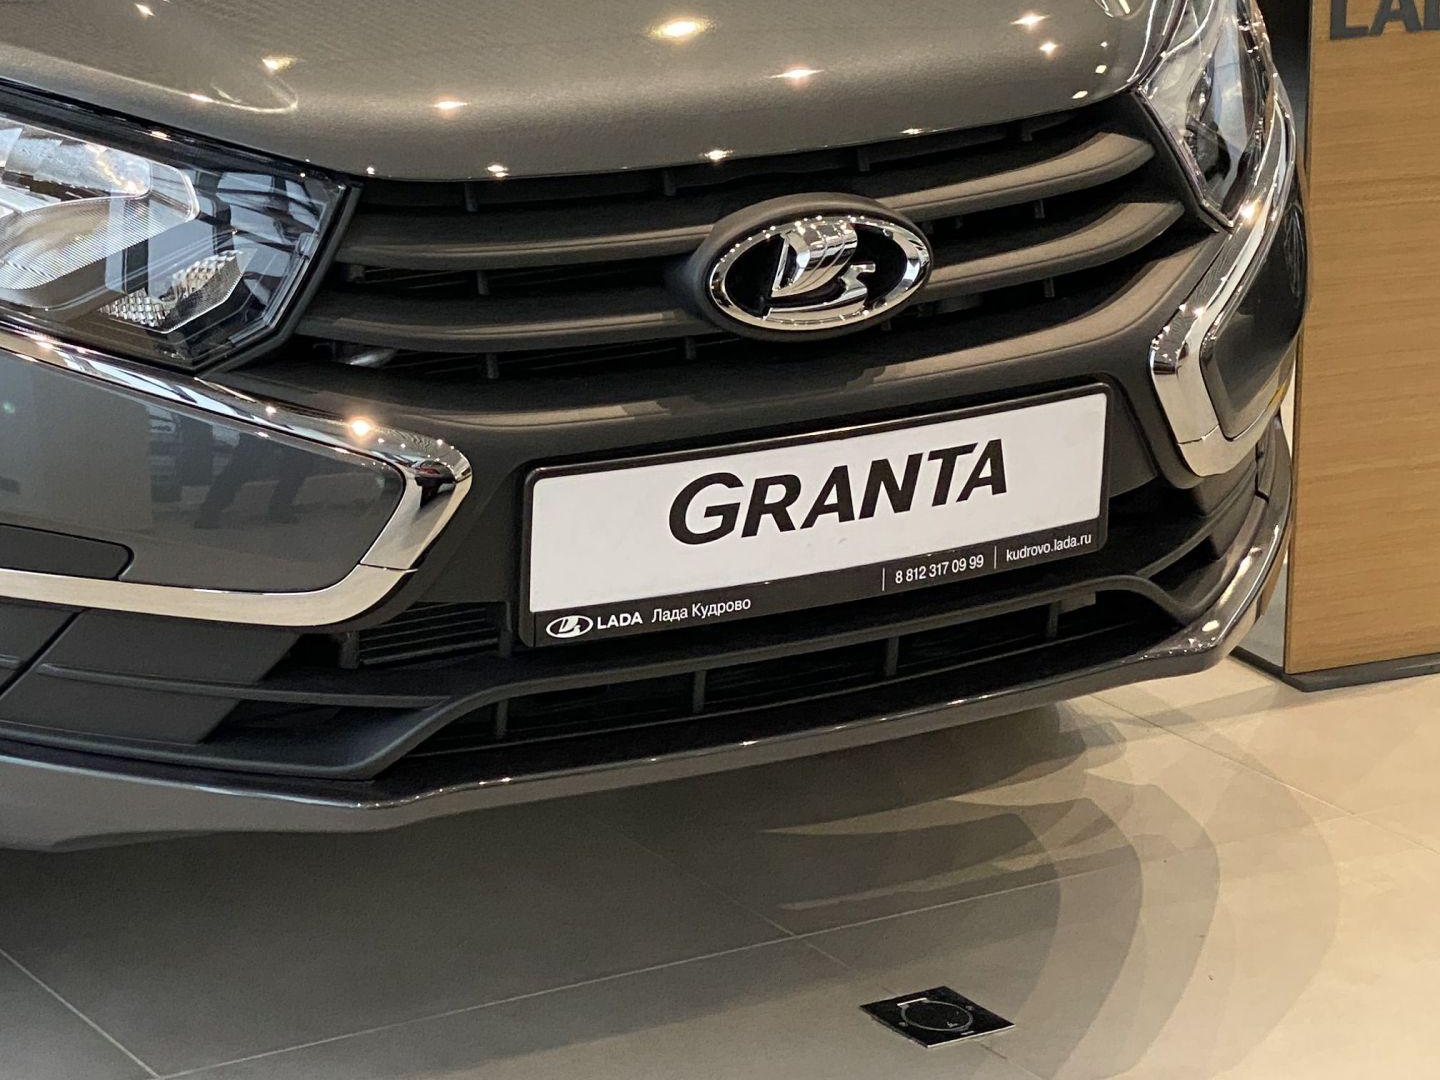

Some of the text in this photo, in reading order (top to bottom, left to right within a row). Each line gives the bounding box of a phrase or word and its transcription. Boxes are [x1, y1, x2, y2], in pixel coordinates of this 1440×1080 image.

[668, 438, 1007, 545] GRANTA
[1006, 533, 1092, 562] kudrovo.lada.ru
[895, 554, 985, 584] 8 812 317 09 99
[597, 598, 752, 630] LADA Лада Кудрово
